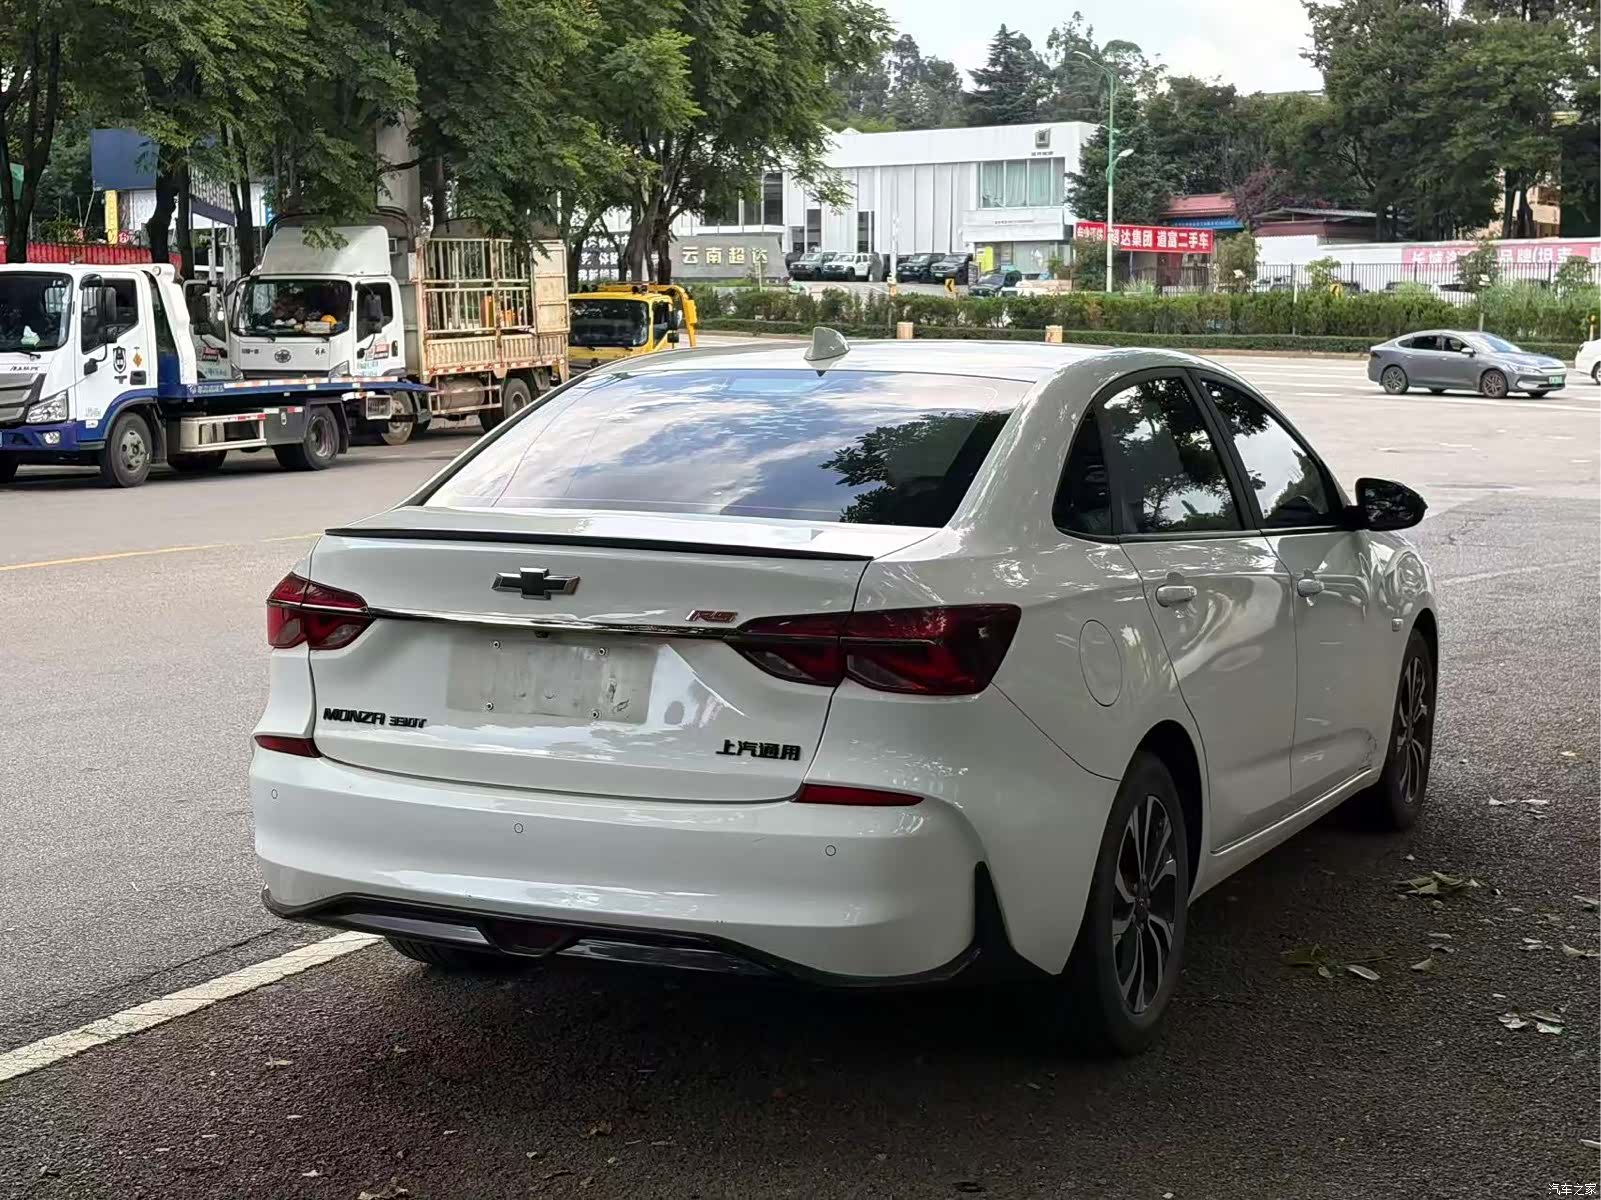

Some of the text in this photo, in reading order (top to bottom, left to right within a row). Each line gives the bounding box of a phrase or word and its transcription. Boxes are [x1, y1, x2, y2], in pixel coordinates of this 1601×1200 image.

[1156, 230, 1209, 249] 道富二手车
[682, 246, 768, 264] 云南超达
[685, 609, 738, 624] RS
[323, 707, 386, 726] MONZA
[715, 739, 802, 761] 上汽通用
